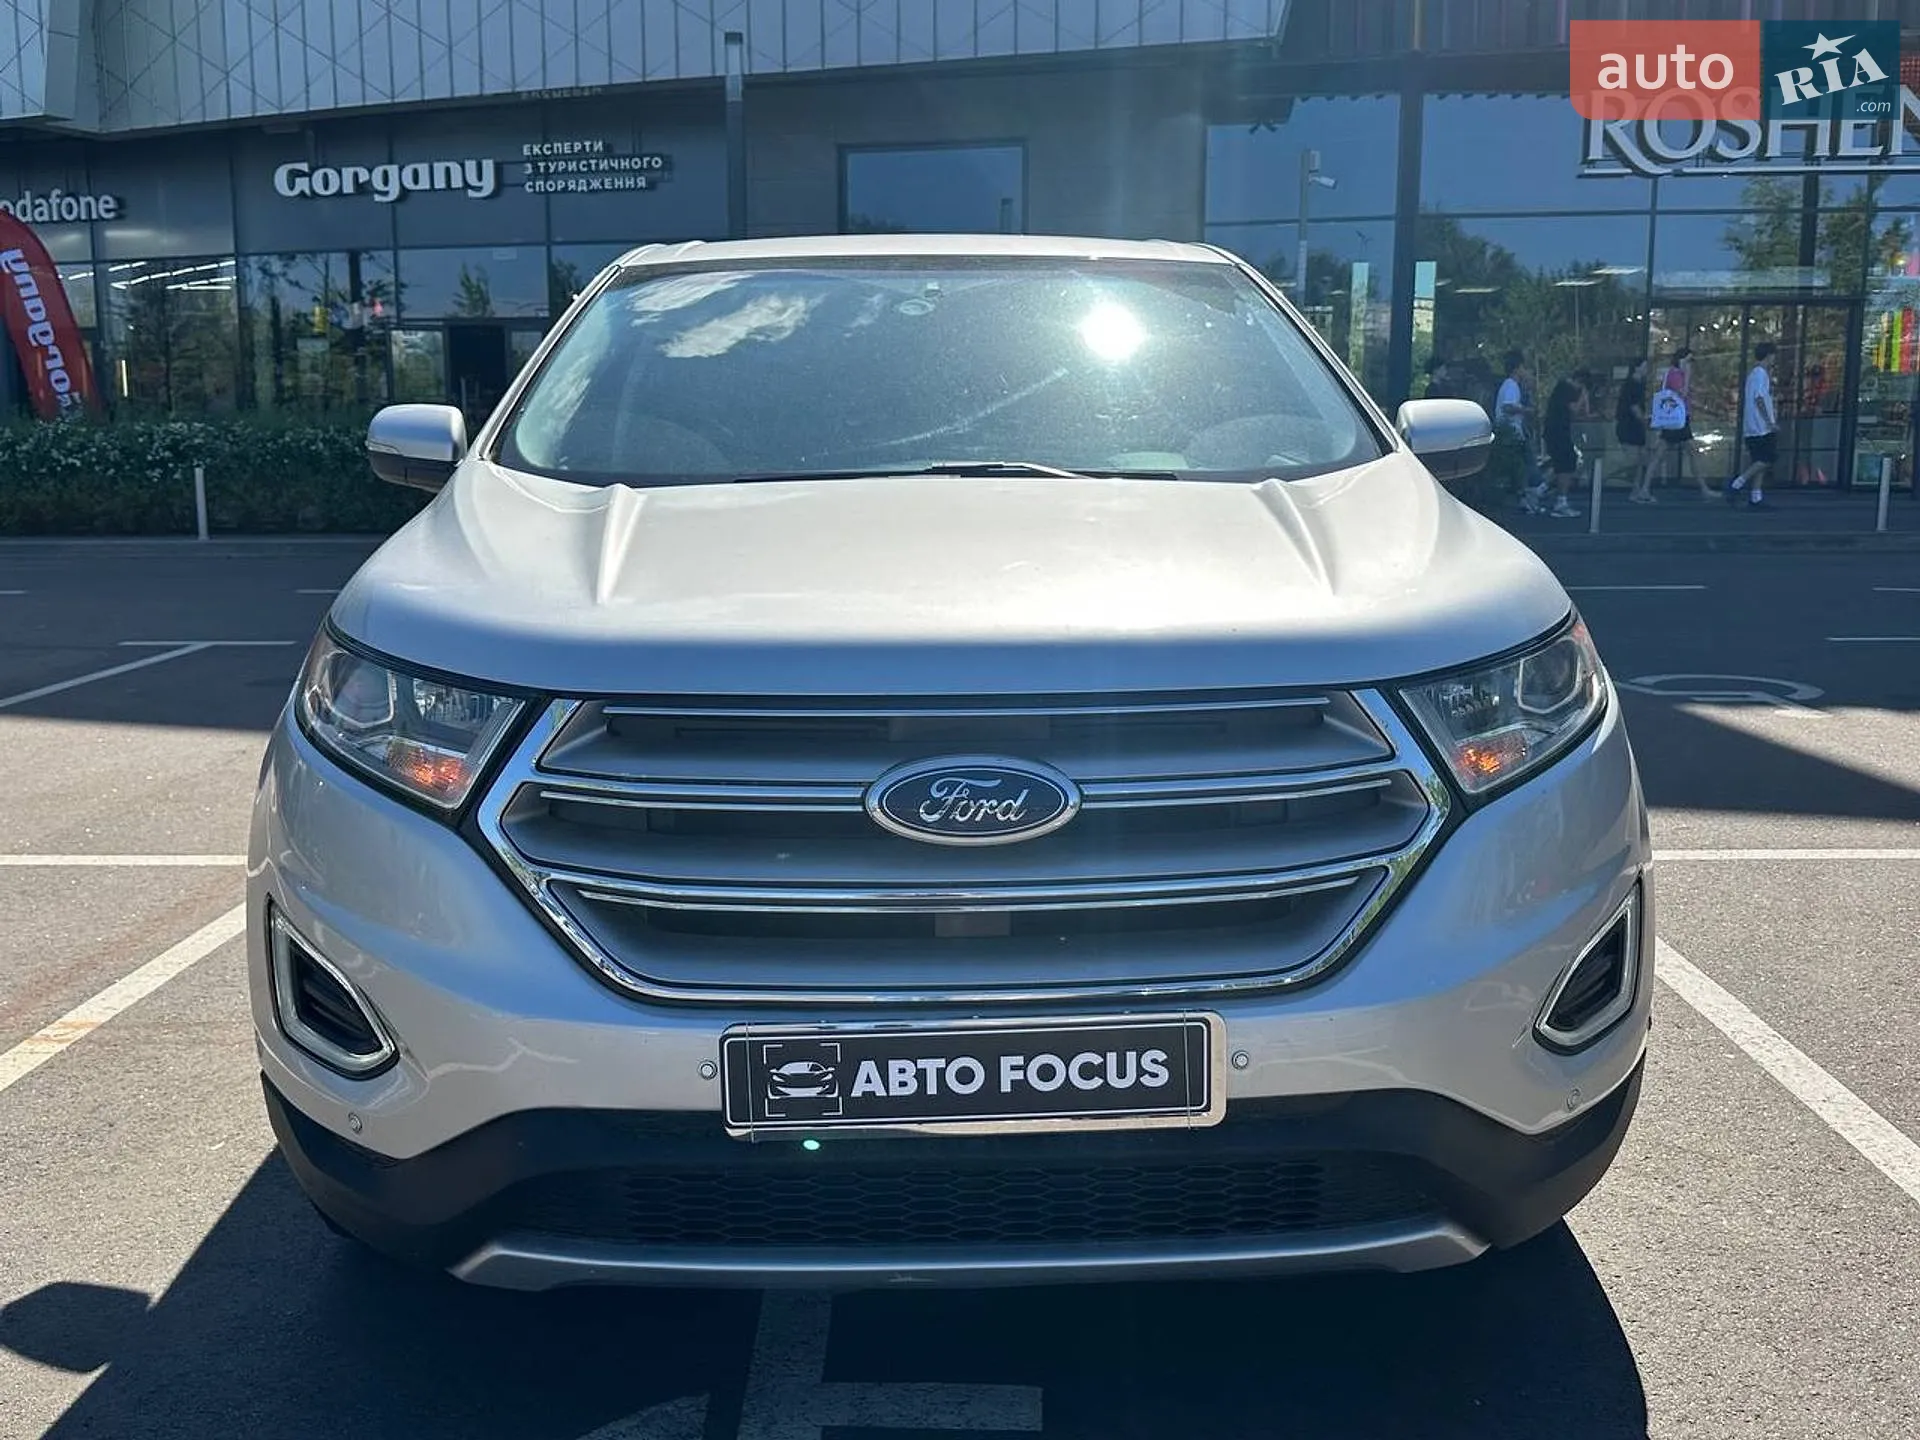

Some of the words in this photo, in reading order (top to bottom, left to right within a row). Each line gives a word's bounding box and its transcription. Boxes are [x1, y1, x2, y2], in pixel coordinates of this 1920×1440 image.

[522, 140, 604, 156] ЕКСПЕРТИ
[274, 158, 495, 202] Gorgany
[537, 156, 663, 174] ТУРИСТИЧНОГО
[524, 175, 647, 193] СПОРЯДЖЕННЯ
[919, 777, 1029, 823] Ford
[850, 1056, 986, 1098] АВТО
[999, 1048, 1170, 1093] FOCUS
